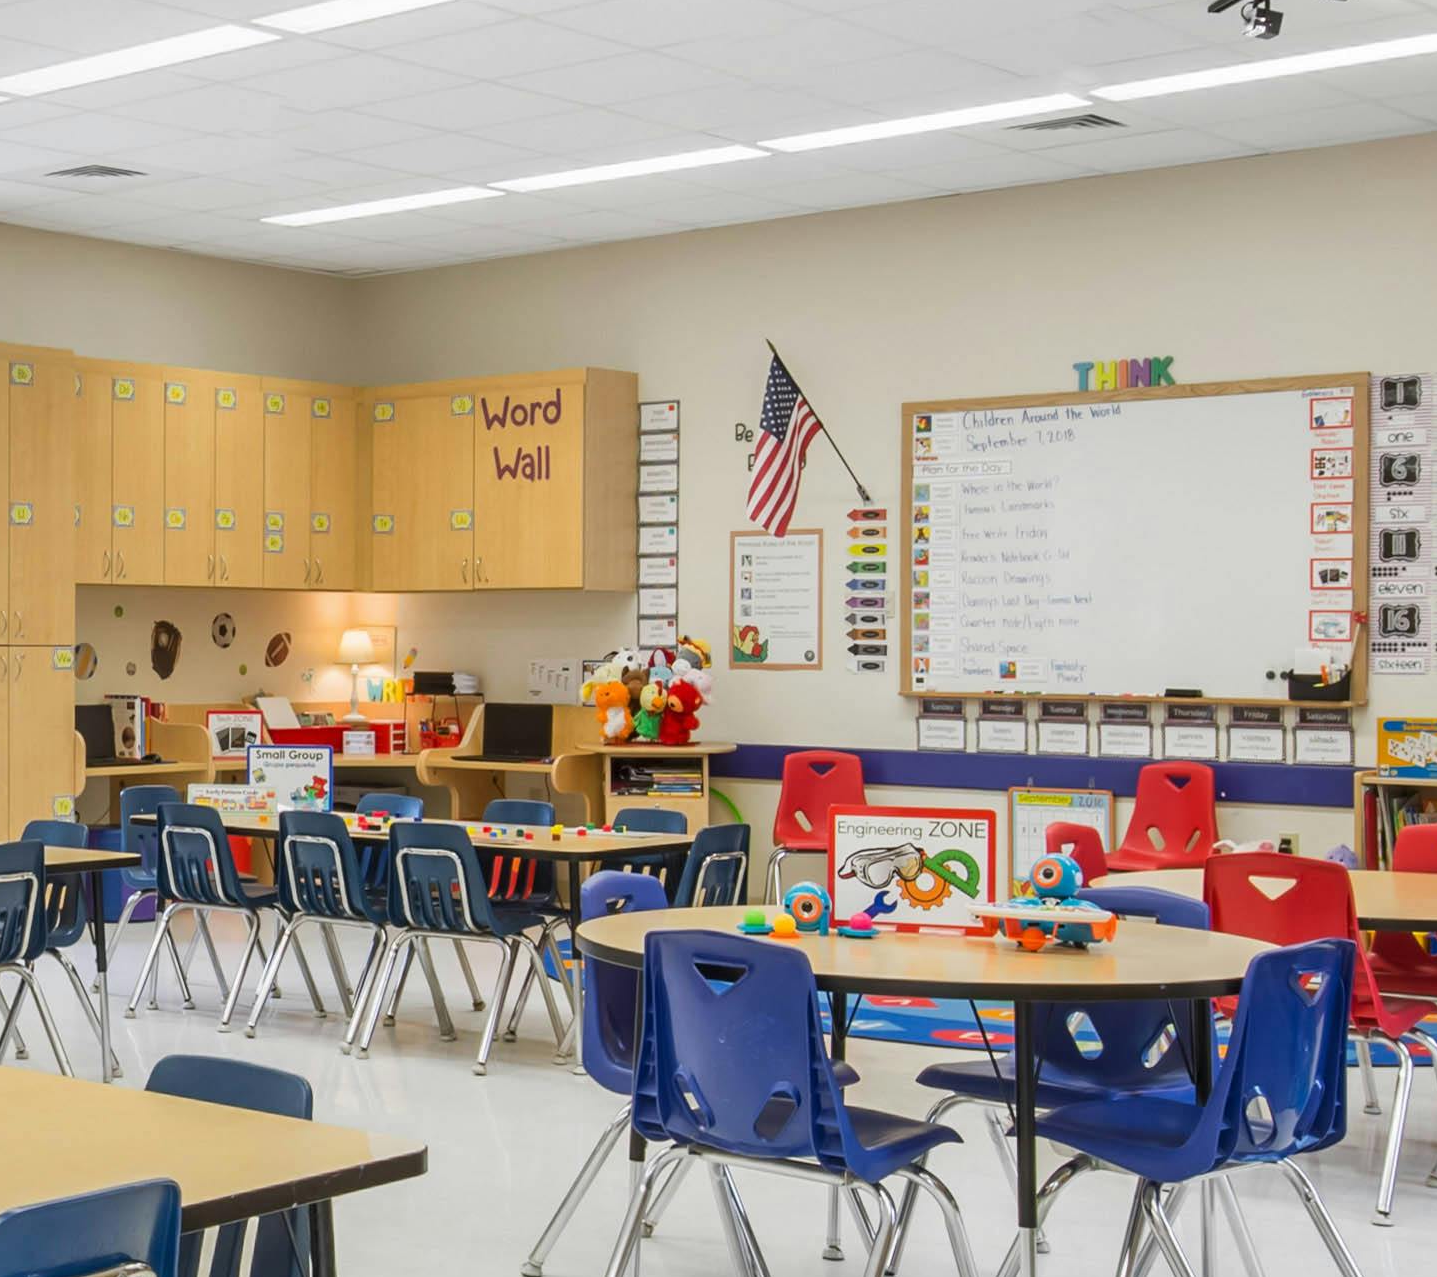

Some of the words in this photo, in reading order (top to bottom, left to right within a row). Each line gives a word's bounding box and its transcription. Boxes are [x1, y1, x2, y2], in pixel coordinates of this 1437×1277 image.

[1072, 355, 1176, 392] THINK
[1396, 380, 1404, 404] 1
[481, 388, 561, 431] Word
[963, 411, 1014, 430] Children
[1021, 408, 1059, 425] Around
[1066, 406, 1084, 420] the
[1090, 404, 1121, 417] World
[735, 423, 753, 442] Be
[1387, 431, 1414, 443] one
[967, 434, 1028, 453] September
[493, 445, 550, 482] Wall
[961, 462, 978, 473] the
[1392, 457, 1408, 480] 6
[1007, 480, 1023, 492] the
[1389, 506, 1409, 520] six
[1391, 534, 1407, 555] 11
[1378, 582, 1423, 594] eleven
[1387, 609, 1410, 631] 16
[1378, 659, 1422, 670] sixteen
[1174, 707, 1208, 717] Thursday
[1243, 710, 1269, 720] Friday
[1306, 712, 1342, 722] Saturday
[255, 749, 286, 760] Small
[288, 749, 324, 762] Group
[837, 820, 923, 839] Engineering
[928, 821, 987, 839] ZONE
